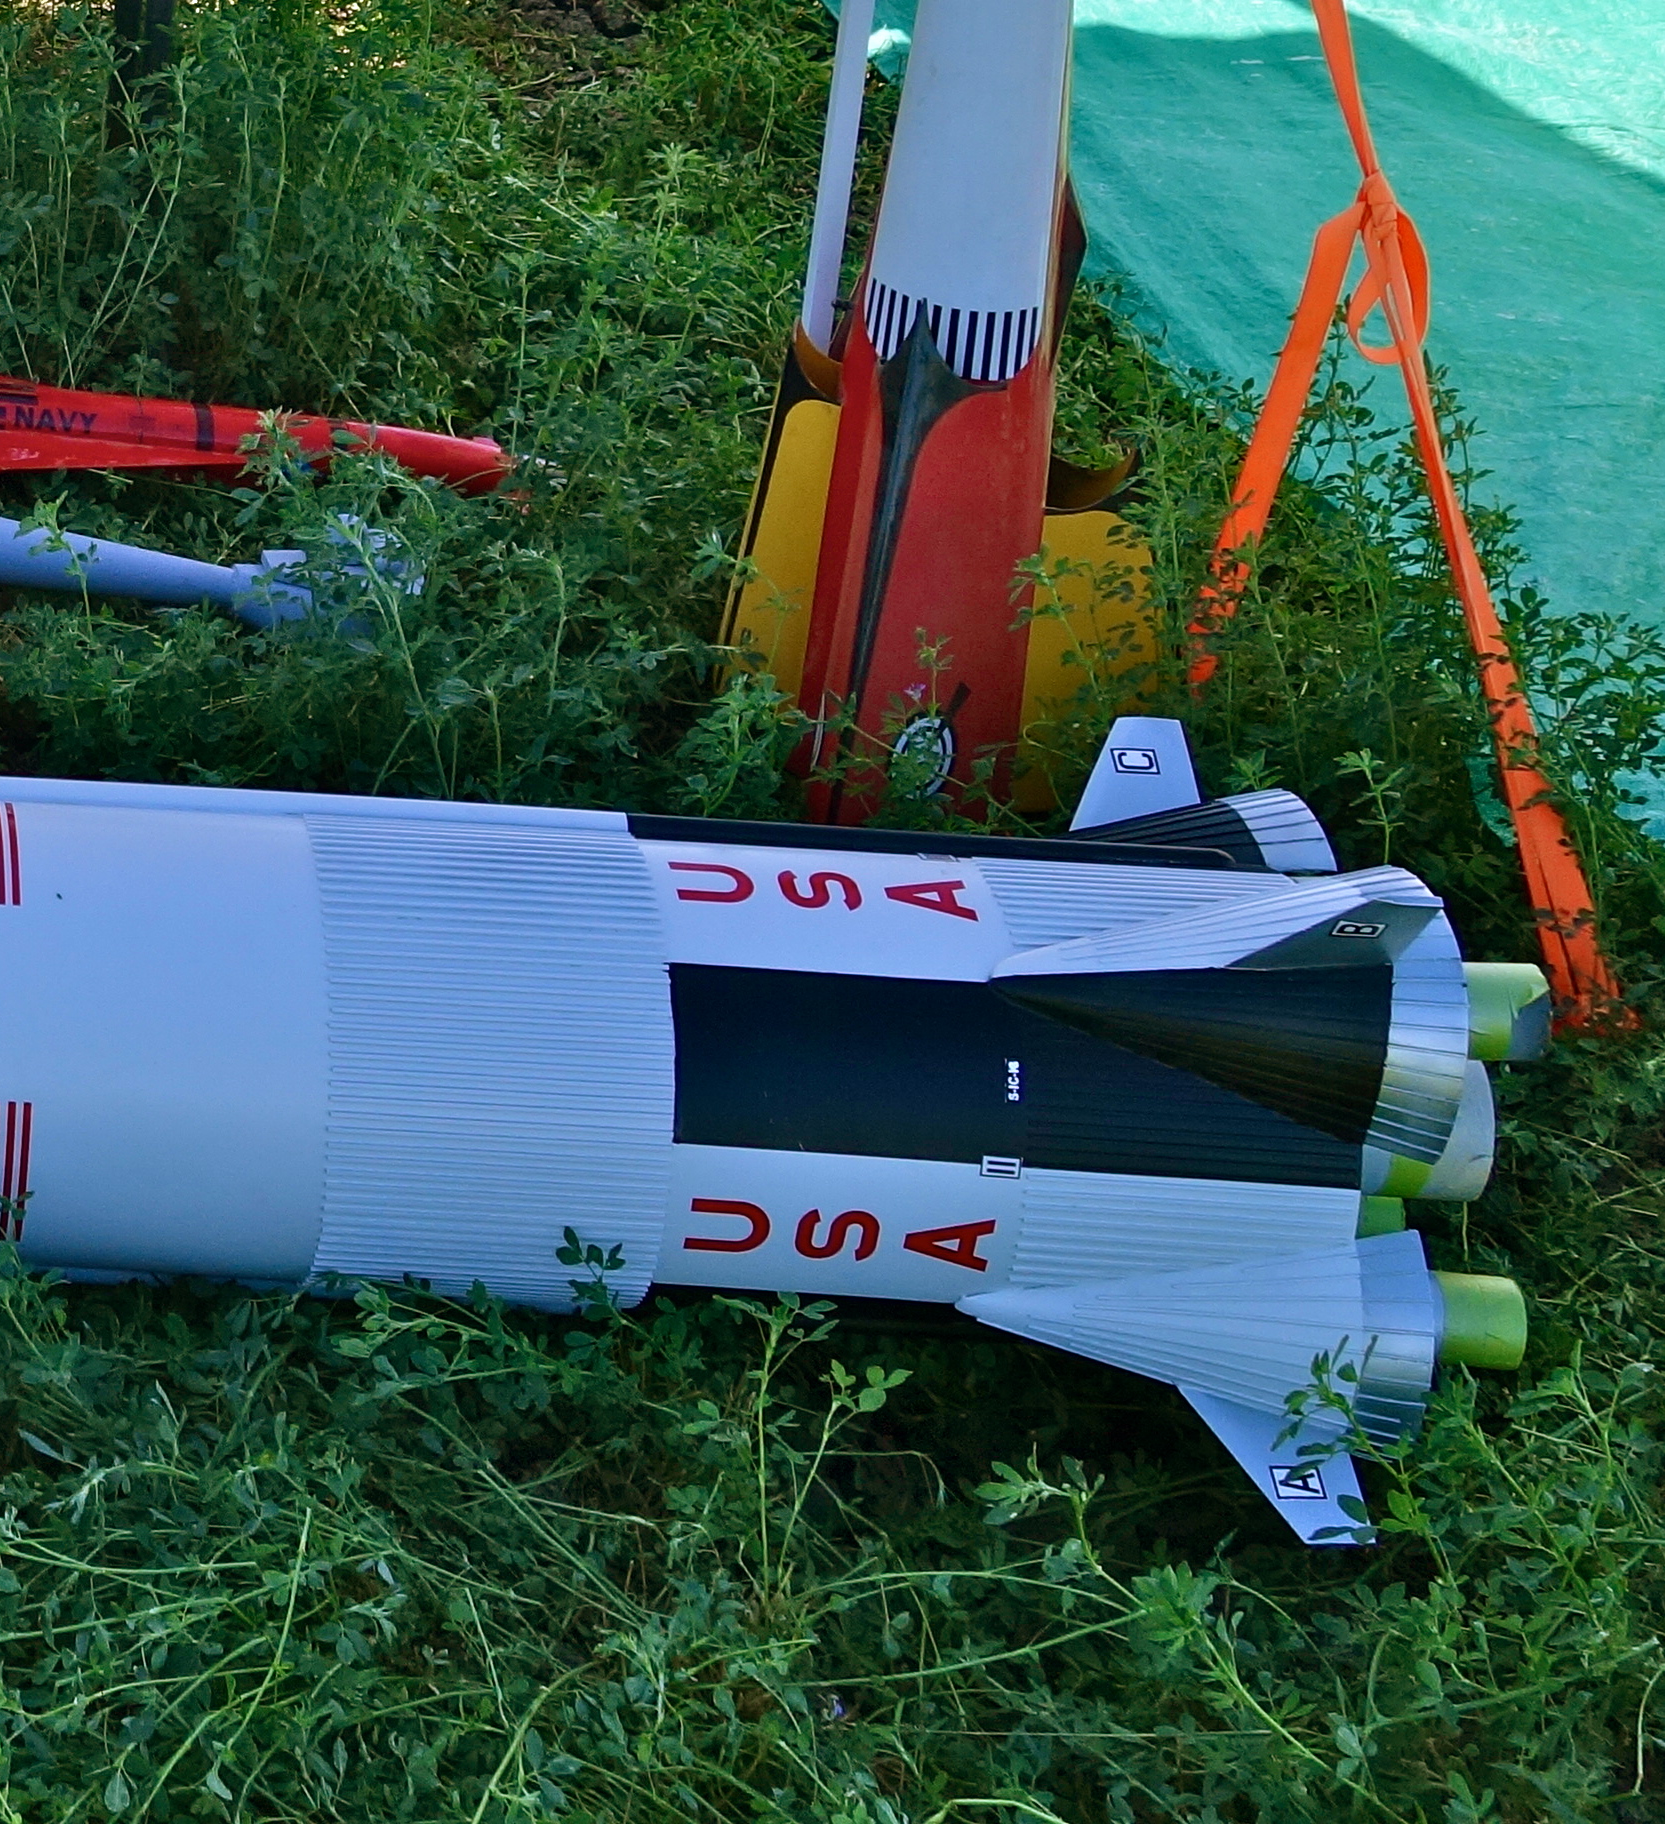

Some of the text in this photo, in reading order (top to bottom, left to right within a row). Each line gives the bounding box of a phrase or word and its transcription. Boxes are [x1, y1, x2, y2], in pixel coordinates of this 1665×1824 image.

[14, 406, 97, 434] NAVY
[1117, 752, 1154, 770] C
[668, 861, 979, 922] USA
[1336, 924, 1380, 936] B
[683, 1198, 996, 1272] USA
[1278, 1472, 1321, 1494] A
